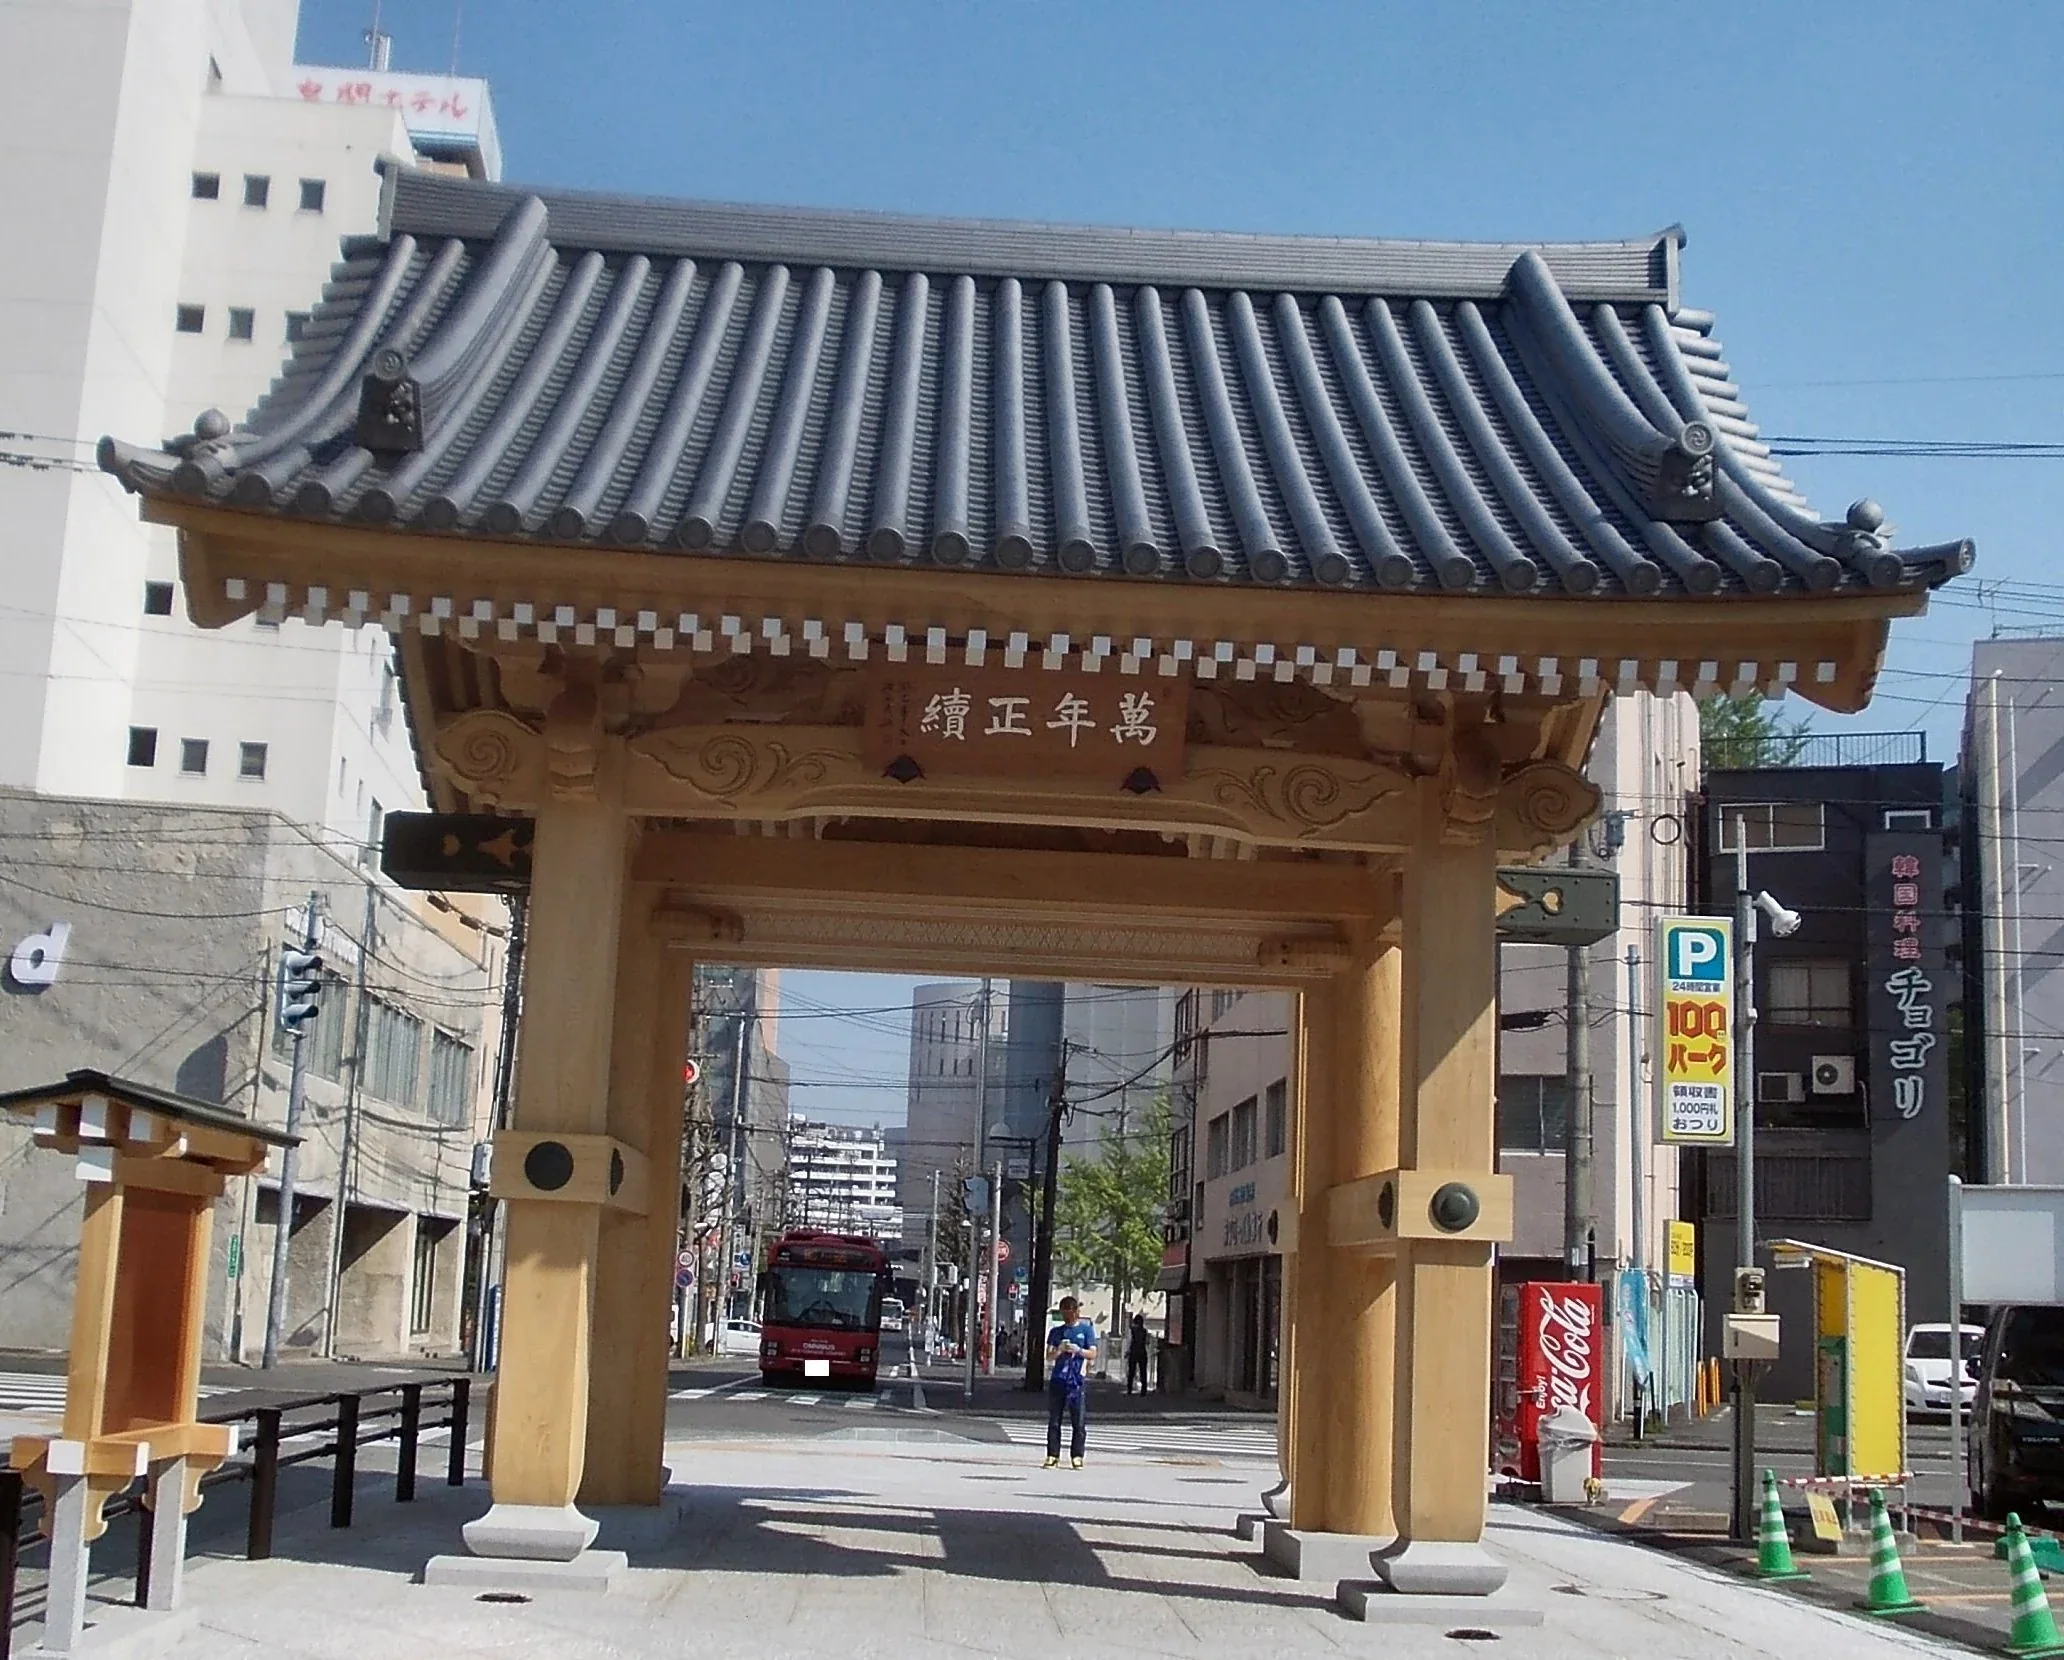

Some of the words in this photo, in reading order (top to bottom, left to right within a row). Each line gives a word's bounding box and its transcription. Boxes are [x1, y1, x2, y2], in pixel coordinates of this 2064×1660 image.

[1892, 855, 1921, 960] 韓国料理
[1678, 932, 1718, 976] P
[1667, 1000, 1727, 1040] 100
[1667, 1043, 1727, 1076] パーク
[1886, 967, 1936, 1119] チョゴリ
[1672, 1086, 1718, 1100] 領収書
[1672, 1118, 1719, 1131] おつり
